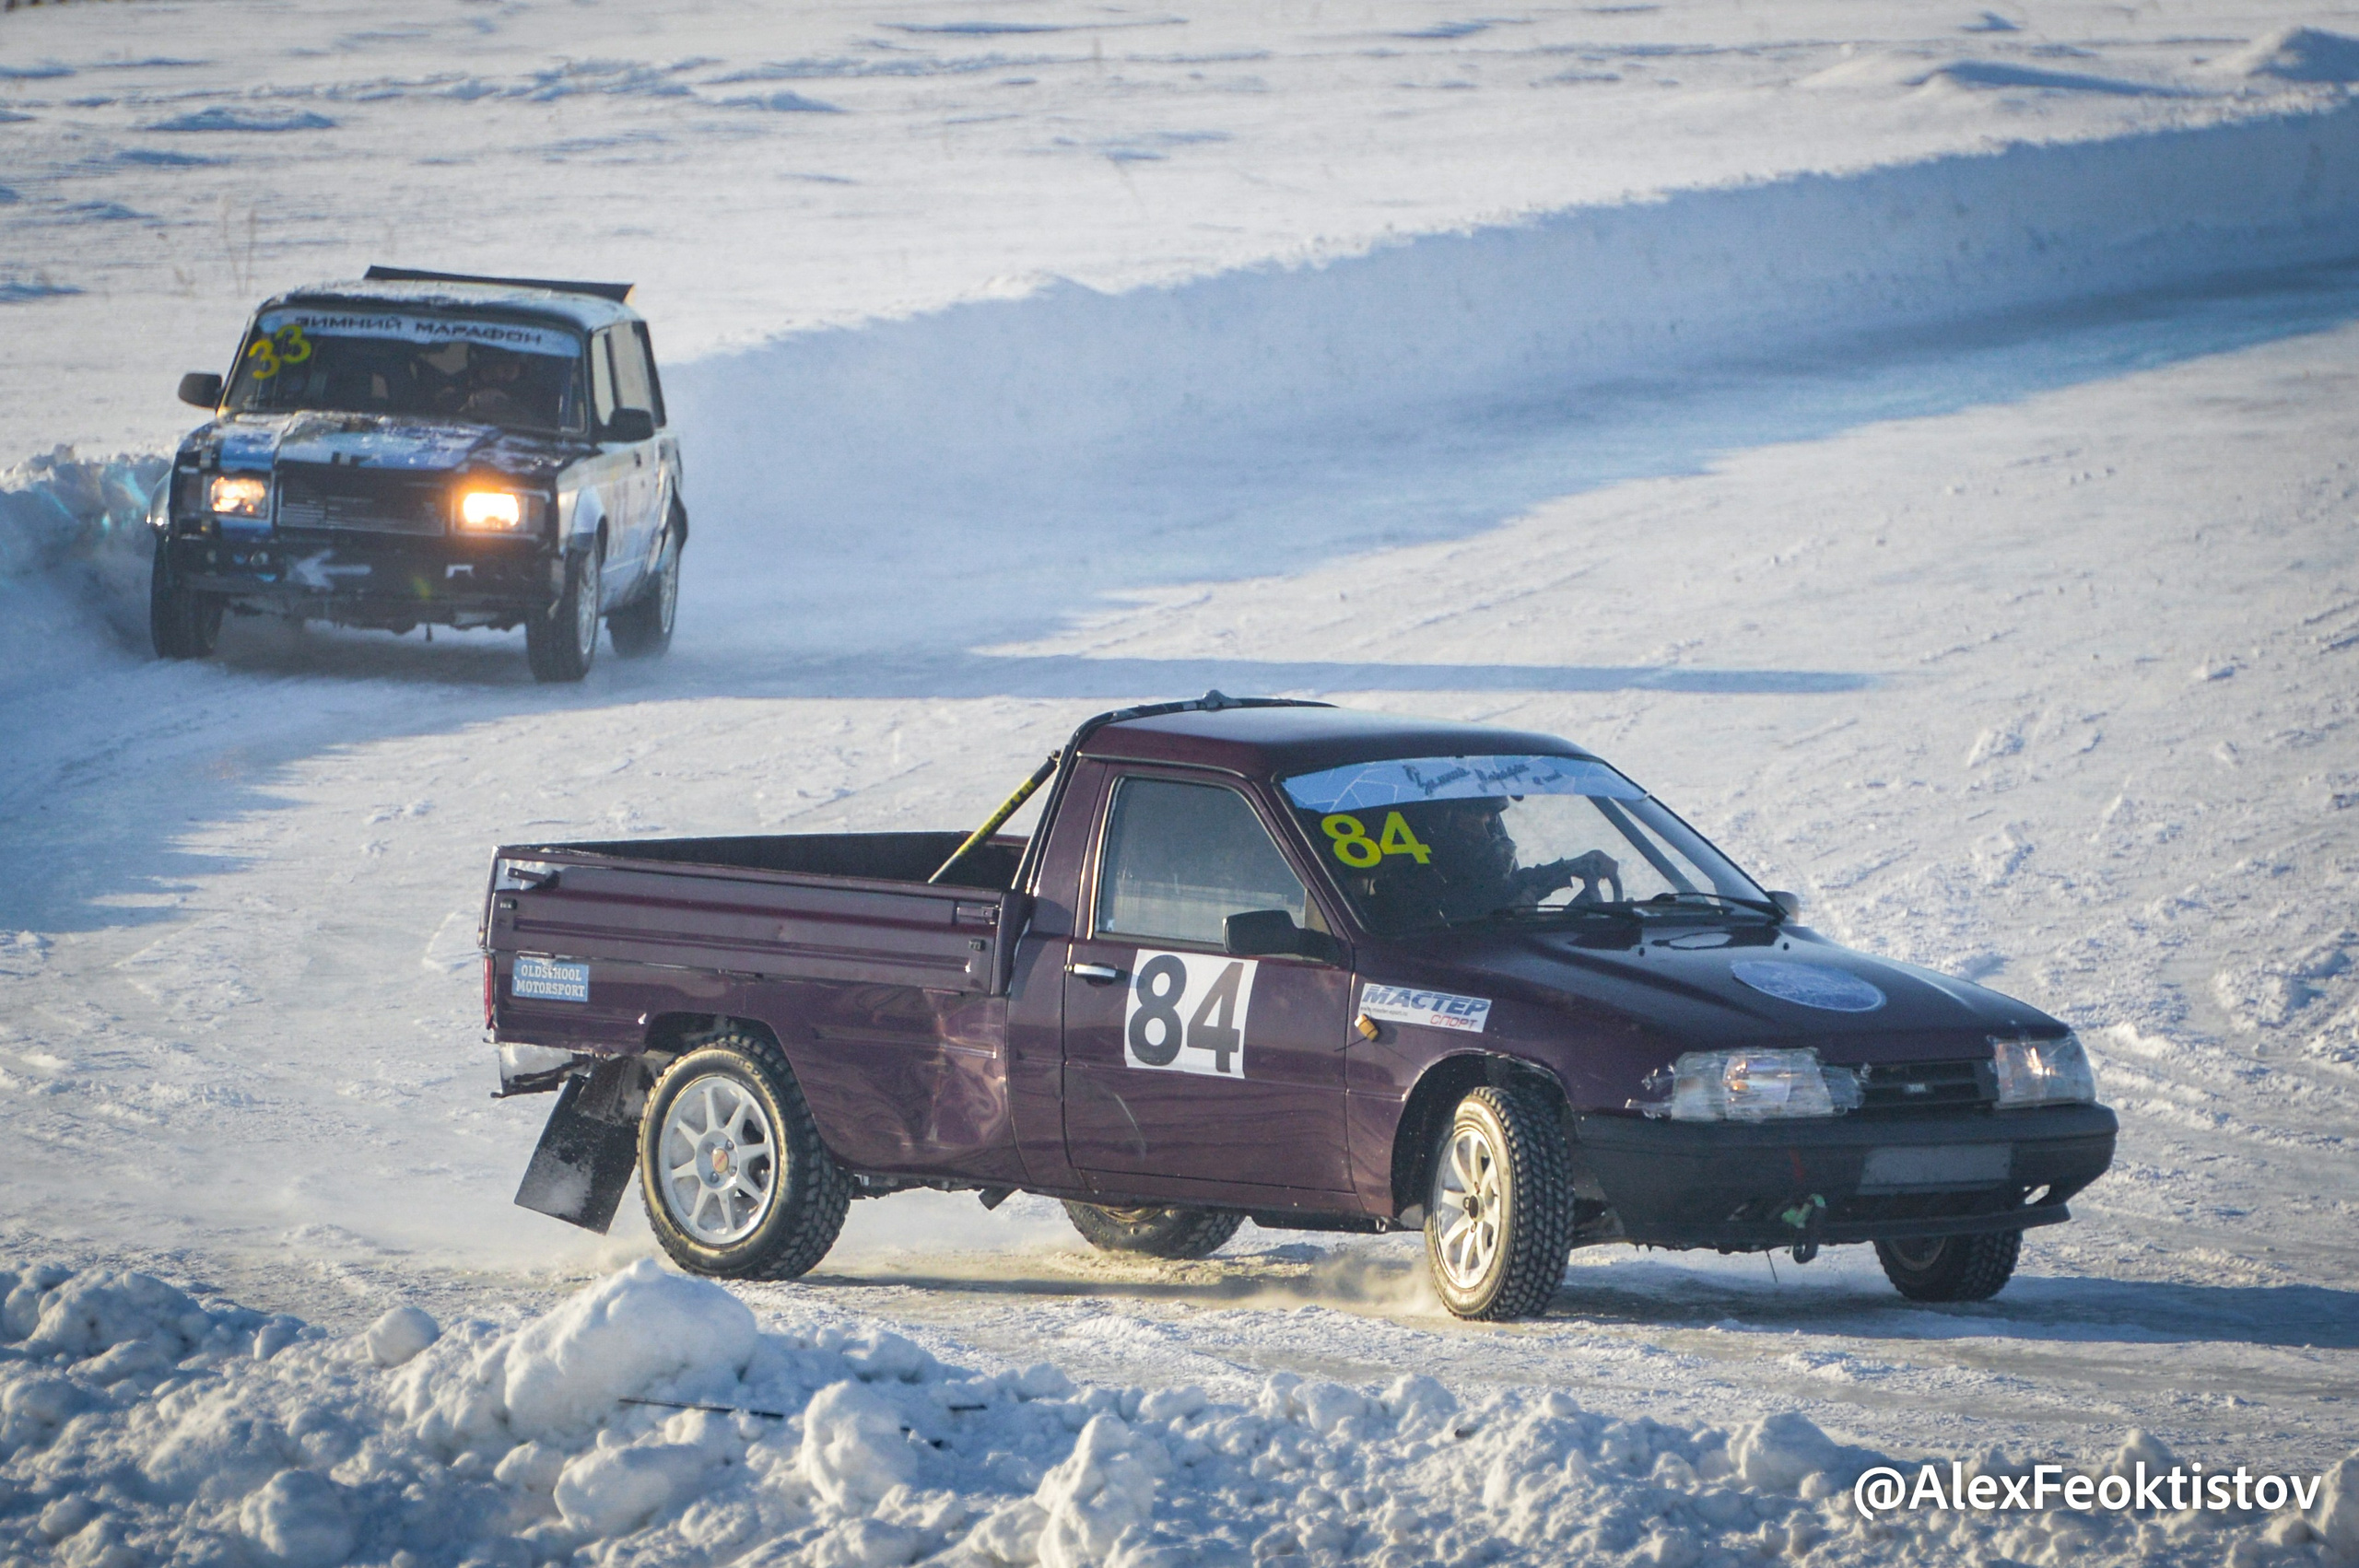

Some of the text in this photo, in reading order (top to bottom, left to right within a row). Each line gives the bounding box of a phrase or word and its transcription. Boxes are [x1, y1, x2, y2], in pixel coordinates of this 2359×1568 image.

[295, 315, 543, 345] ЗИМНИЙ МАРАФОН
[248, 324, 311, 380] 33
[1320, 811, 1433, 869] 84
[516, 979, 586, 998] MOTORSPORT
[1362, 985, 1490, 1016] МАСТЕР
[1128, 954, 1246, 1073] 84
[1430, 1014, 1478, 1029] СПОРТ
